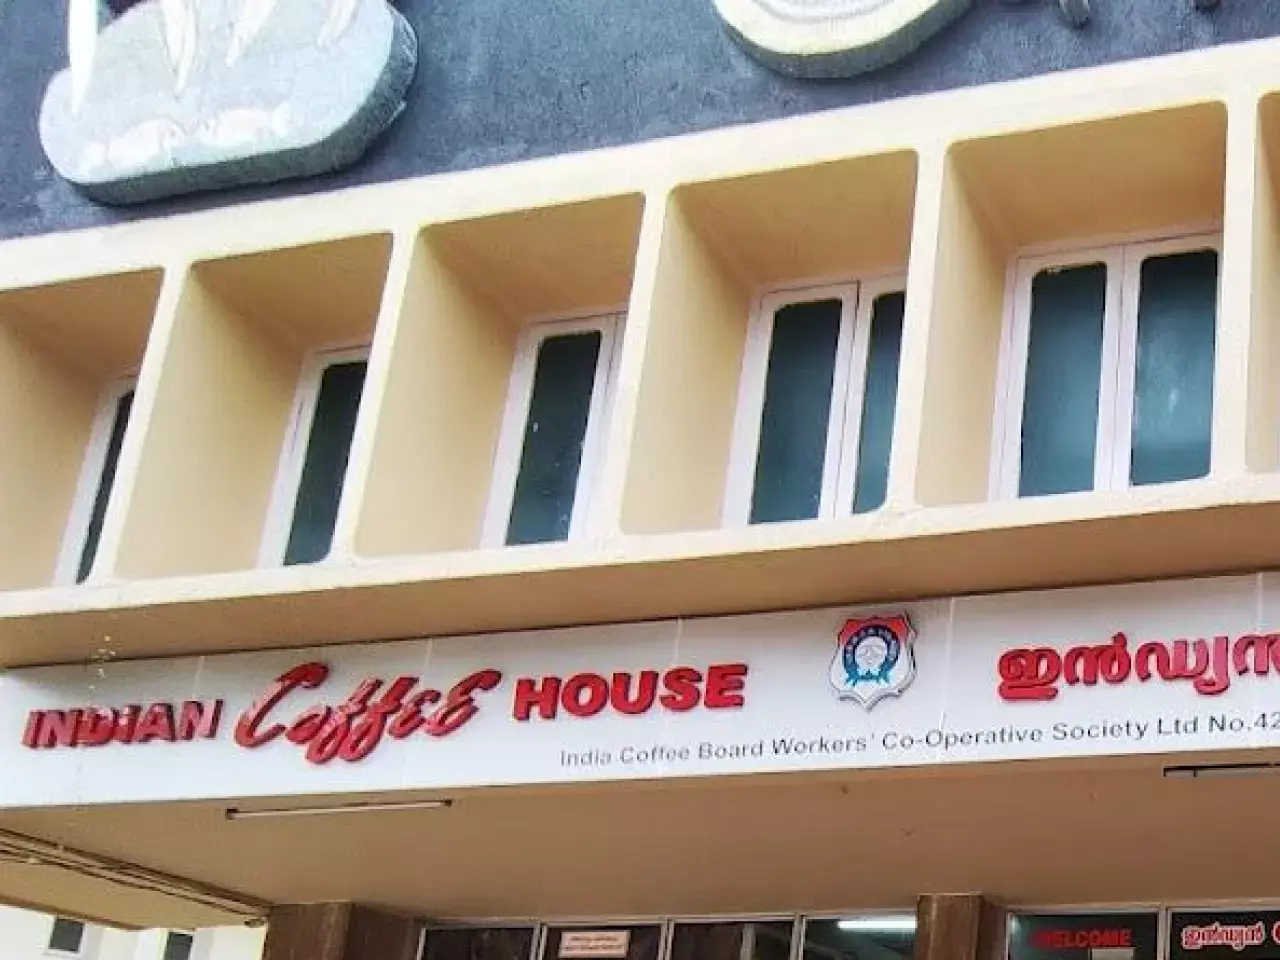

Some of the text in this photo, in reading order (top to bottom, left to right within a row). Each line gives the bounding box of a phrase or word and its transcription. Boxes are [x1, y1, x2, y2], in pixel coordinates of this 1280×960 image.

[22, 698, 224, 750] INDIAN
[513, 662, 748, 721] HOUSE
[561, 749, 613, 767] India
[619, 743, 691, 765] Coffee
[698, 738, 764, 760] Board
[882, 724, 1043, 750] Co-Operative
[1052, 718, 1149, 742] Society
[1157, 715, 1199, 735] Ltd
